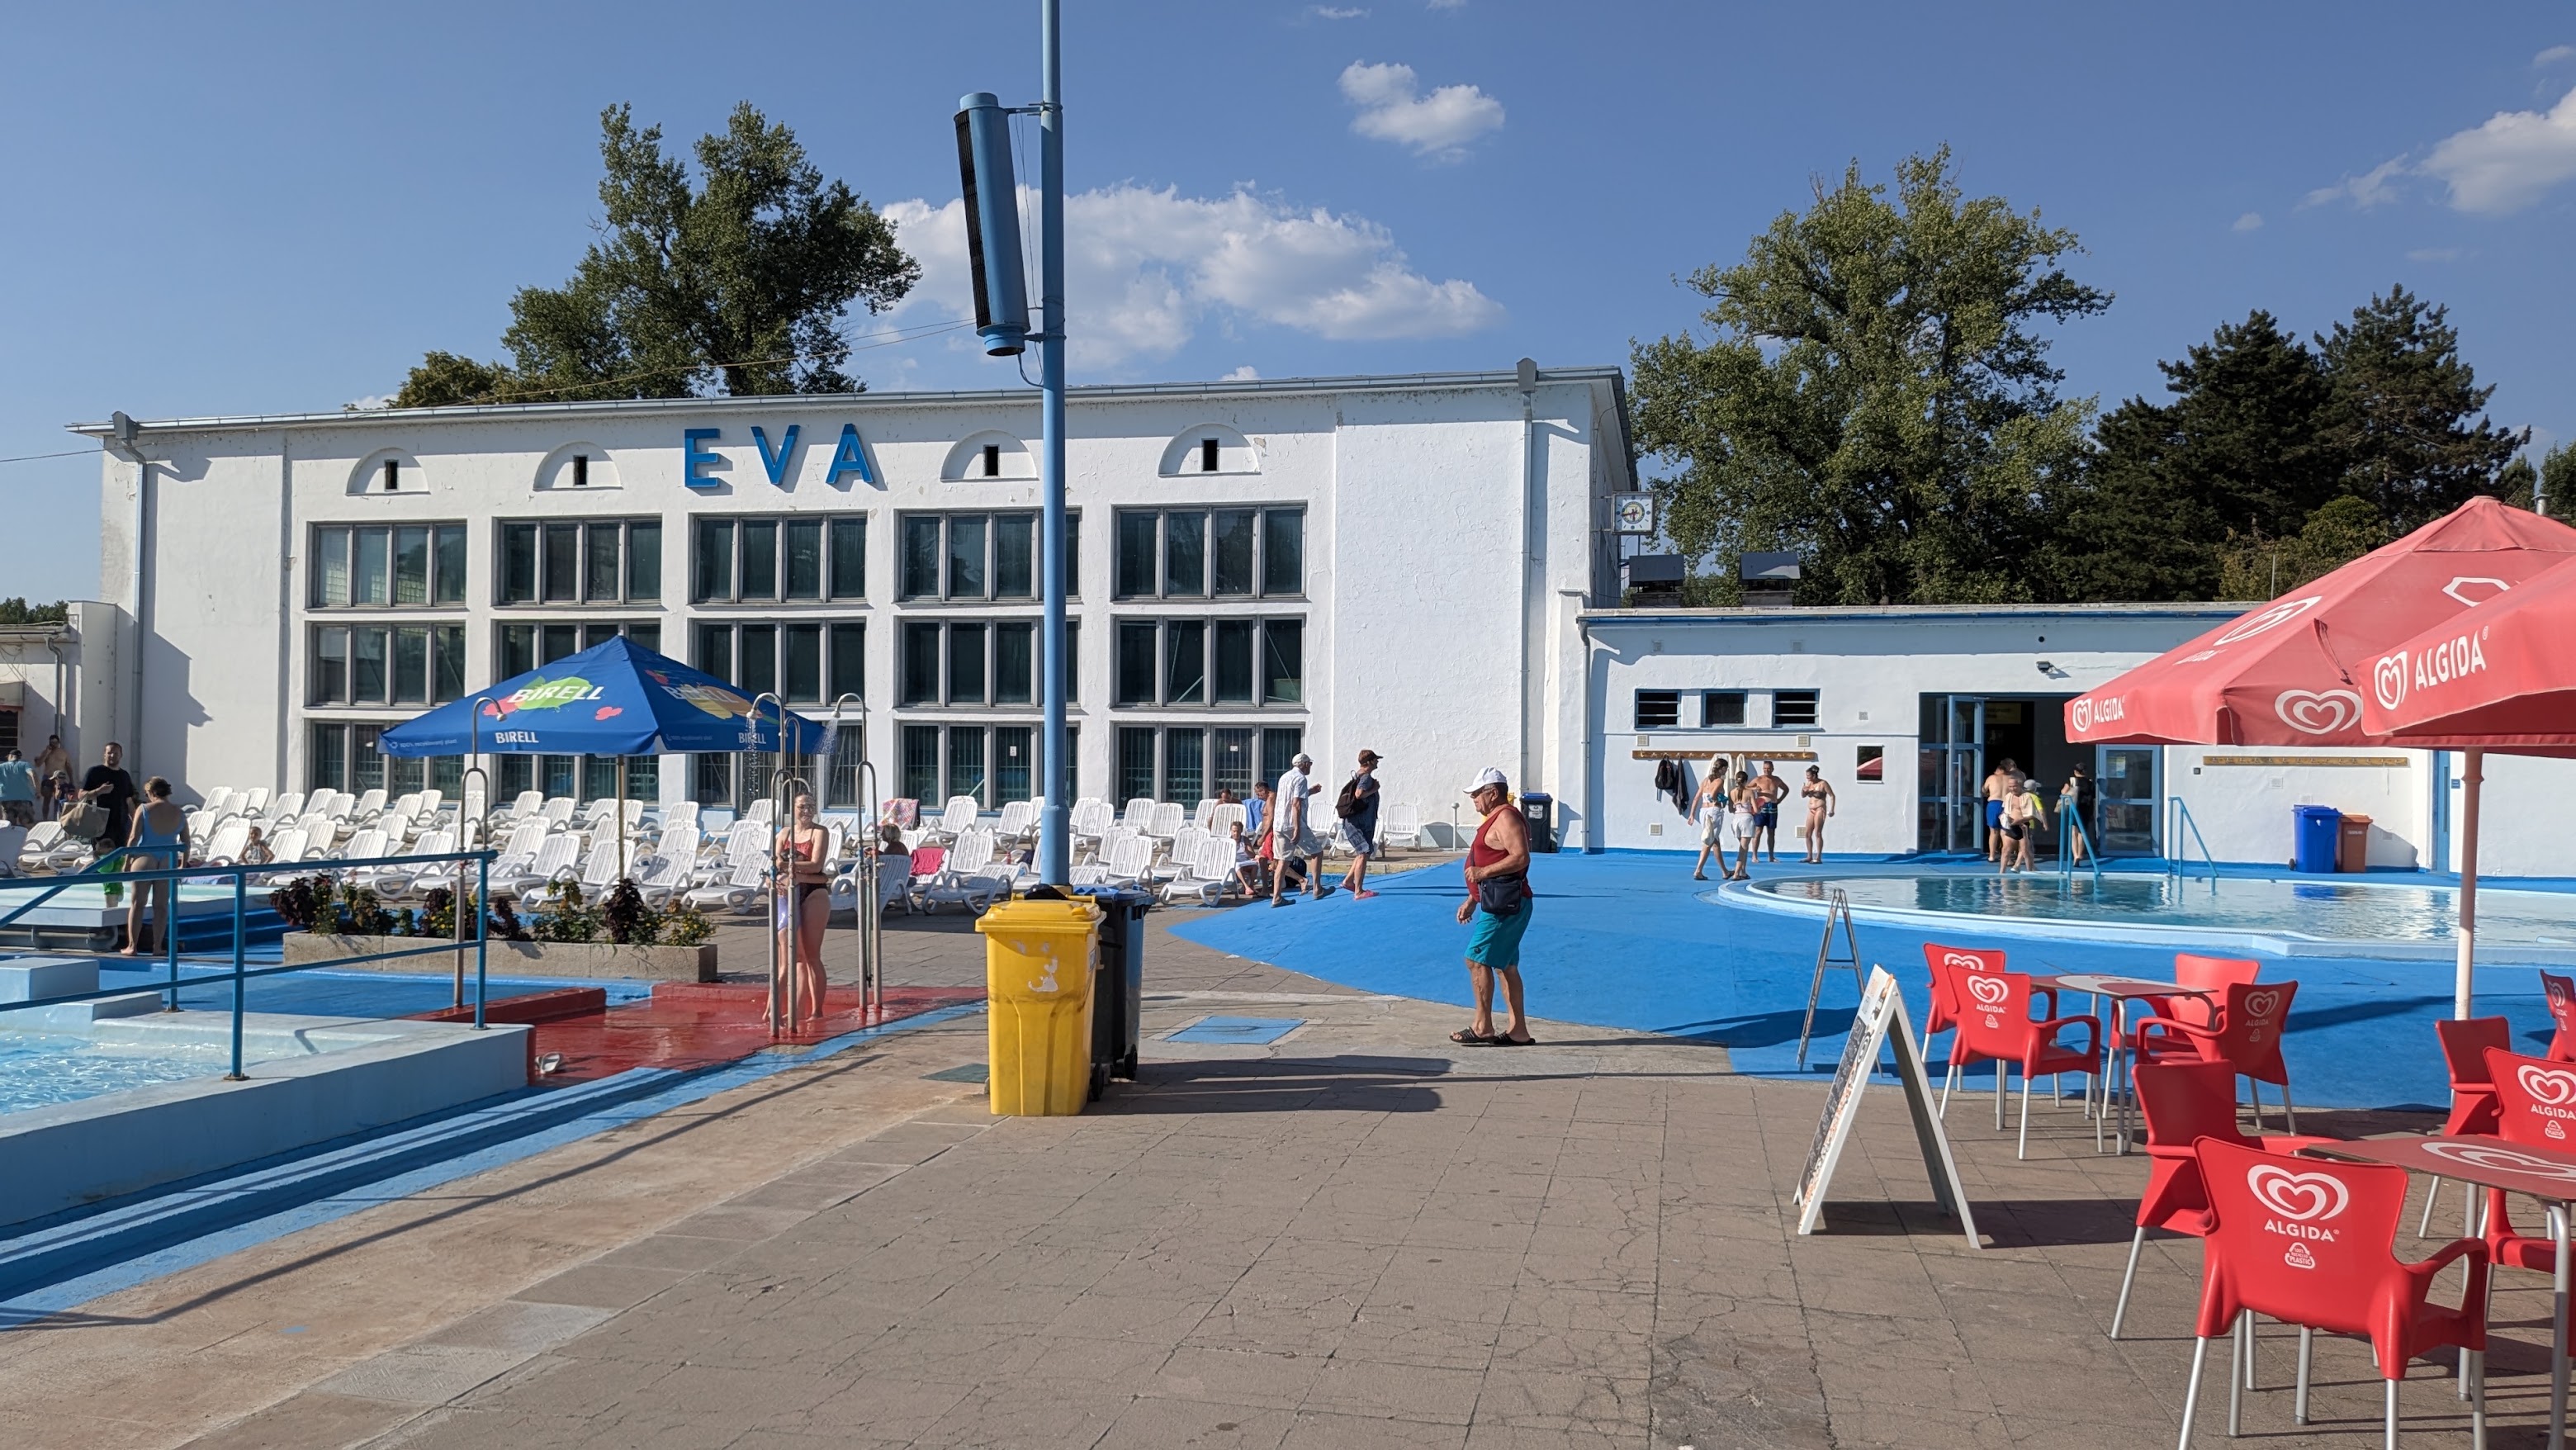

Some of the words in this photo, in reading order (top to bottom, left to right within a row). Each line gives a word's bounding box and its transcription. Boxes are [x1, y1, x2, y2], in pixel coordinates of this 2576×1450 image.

[684, 423, 876, 488] EVA
[507, 685, 604, 704] BIRELL
[495, 731, 539, 744] BIRELL
[2290, 1255, 2312, 1266] PLASTIC
